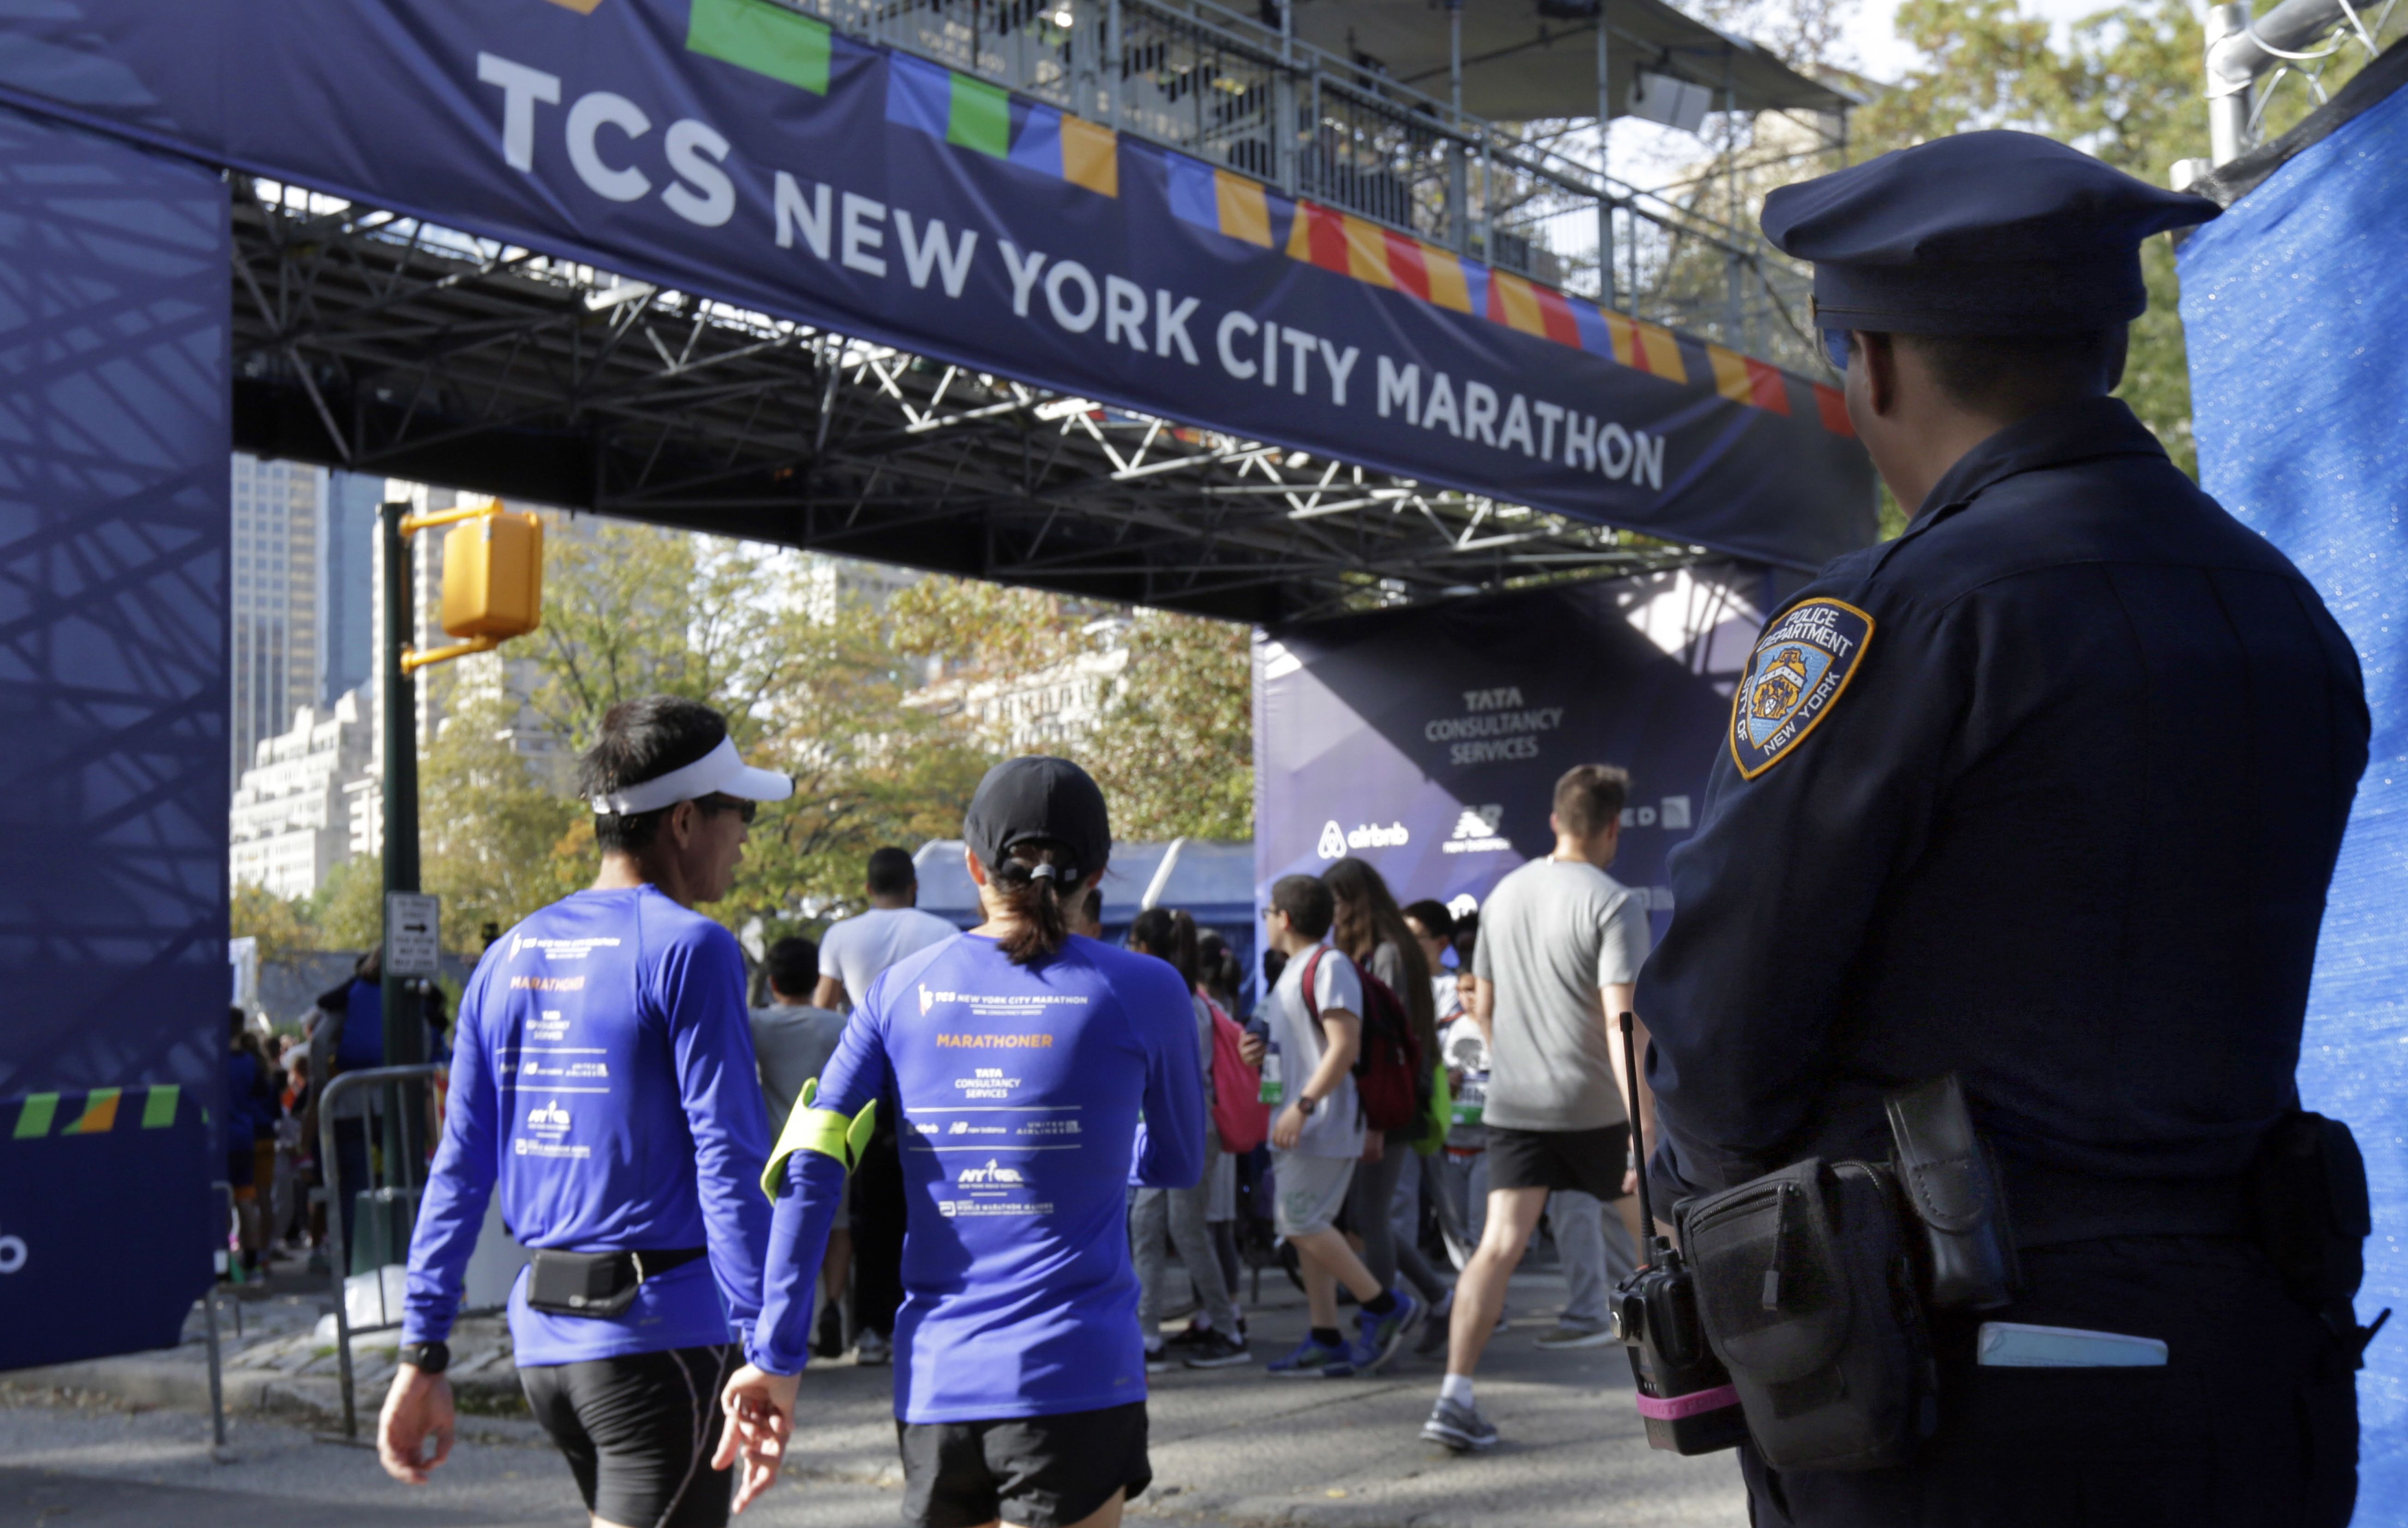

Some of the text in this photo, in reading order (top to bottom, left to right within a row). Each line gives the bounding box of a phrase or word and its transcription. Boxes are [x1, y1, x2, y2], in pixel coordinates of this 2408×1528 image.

[476, 51, 1665, 490] TCS NEW YORK CITY MARATHON
[1785, 607, 1840, 628] POLICE
[1757, 623, 1853, 658] DEPARTMENT
[1463, 686, 1524, 712] TATA
[1425, 706, 1563, 742] CONSULTANCY
[1737, 720, 1748, 741] OF
[1763, 720, 1796, 756] NEW
[1798, 671, 1841, 718] YORK
[1450, 736, 1539, 765] SERVICES
[1347, 821, 1409, 849] airbnb
[935, 992, 1089, 1005] TCS NEW YORK CITY MARATHON
[936, 1034, 1053, 1049] MARATHONER
[954, 1078, 1022, 1088] CONSULTANCY
[975, 1068, 1003, 1078] TATA
[966, 1088, 1008, 1099] SERVICES
